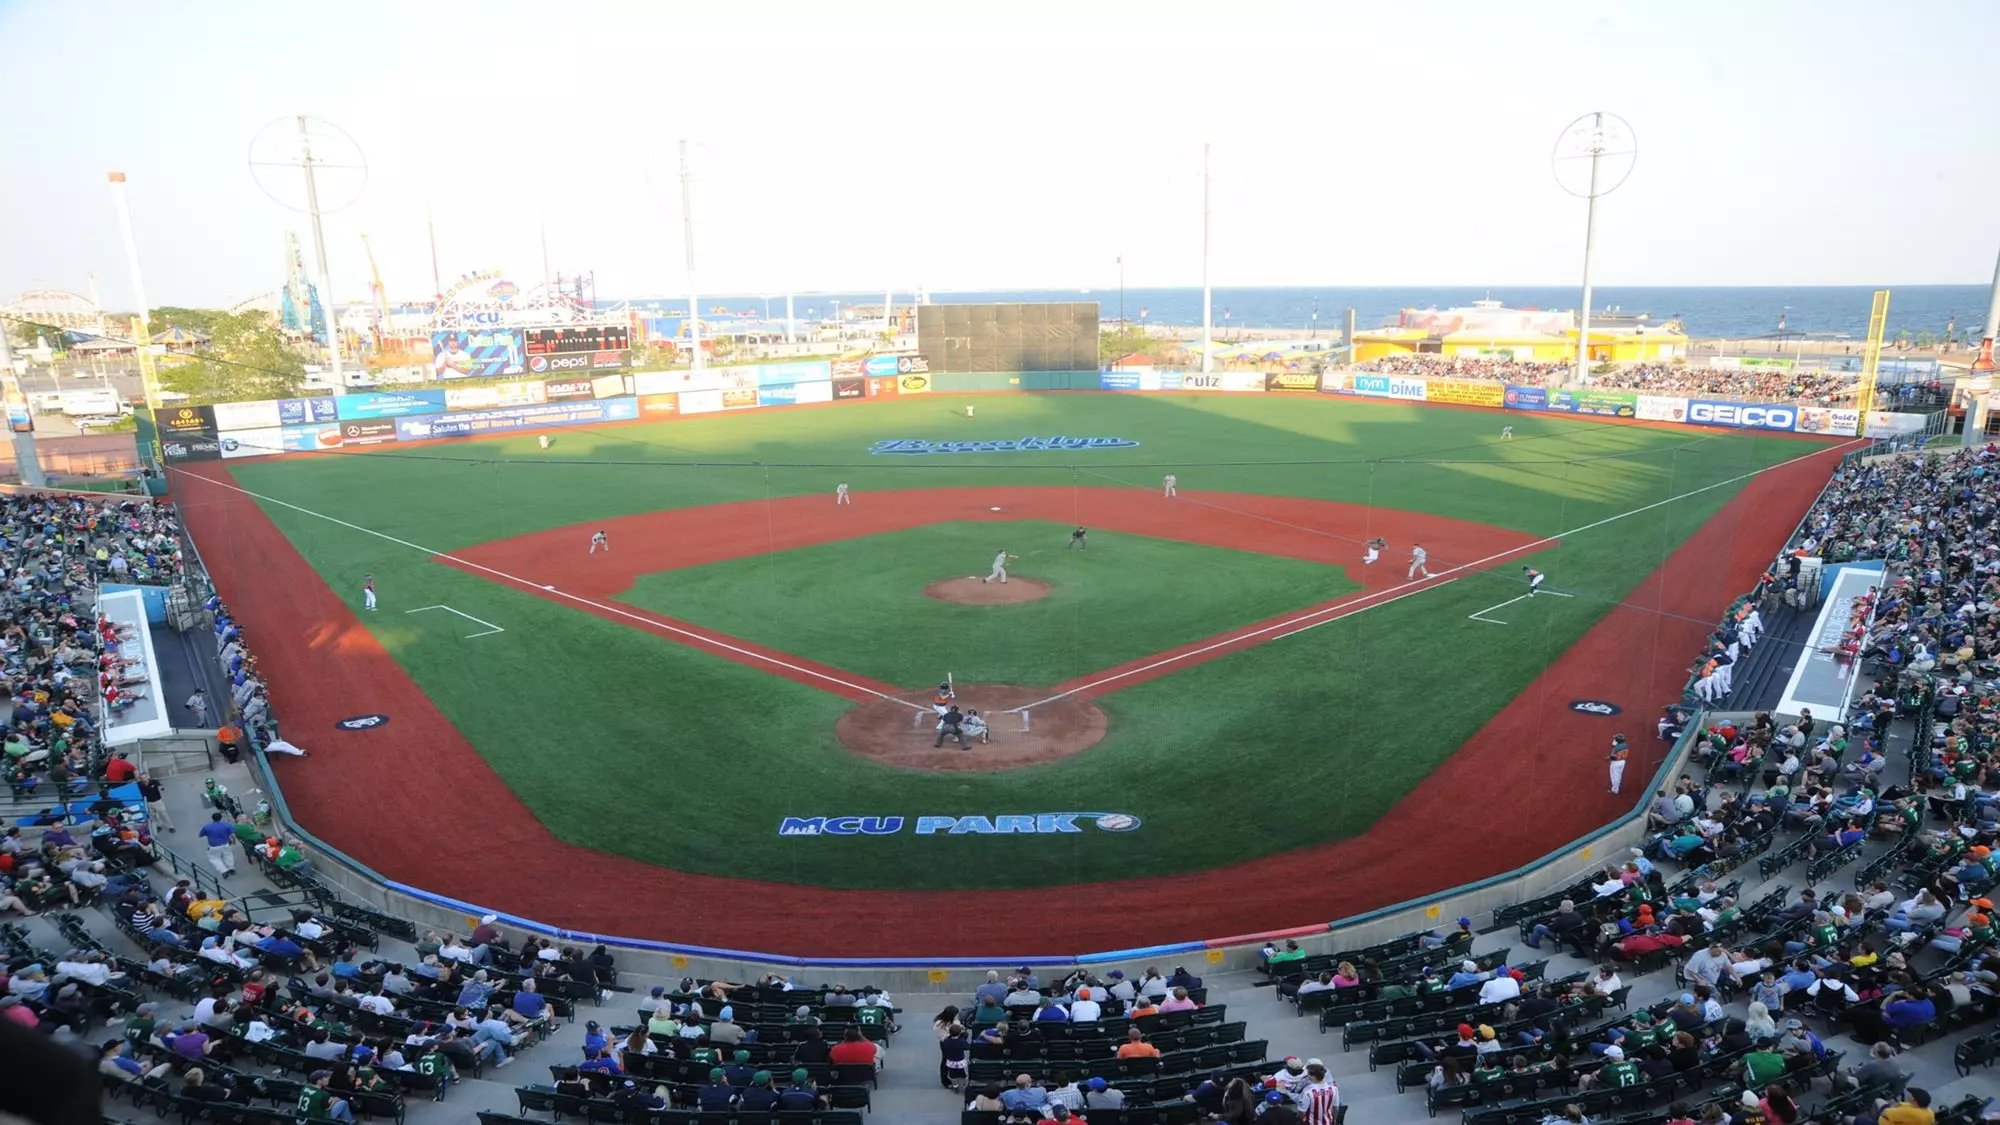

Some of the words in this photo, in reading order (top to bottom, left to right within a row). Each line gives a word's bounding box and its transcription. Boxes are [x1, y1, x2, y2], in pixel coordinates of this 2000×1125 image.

[462, 312, 500, 323] MCU
[551, 355, 588, 370] pepsi
[1690, 404, 1794, 428] GEICO
[868, 436, 1140, 455] Brooklyn
[779, 816, 904, 835] MCU
[915, 814, 1082, 834] PARK
[420, 1062, 434, 1075] 13
[1620, 1073, 1635, 1088] 13
[298, 1095, 310, 1112] 13
